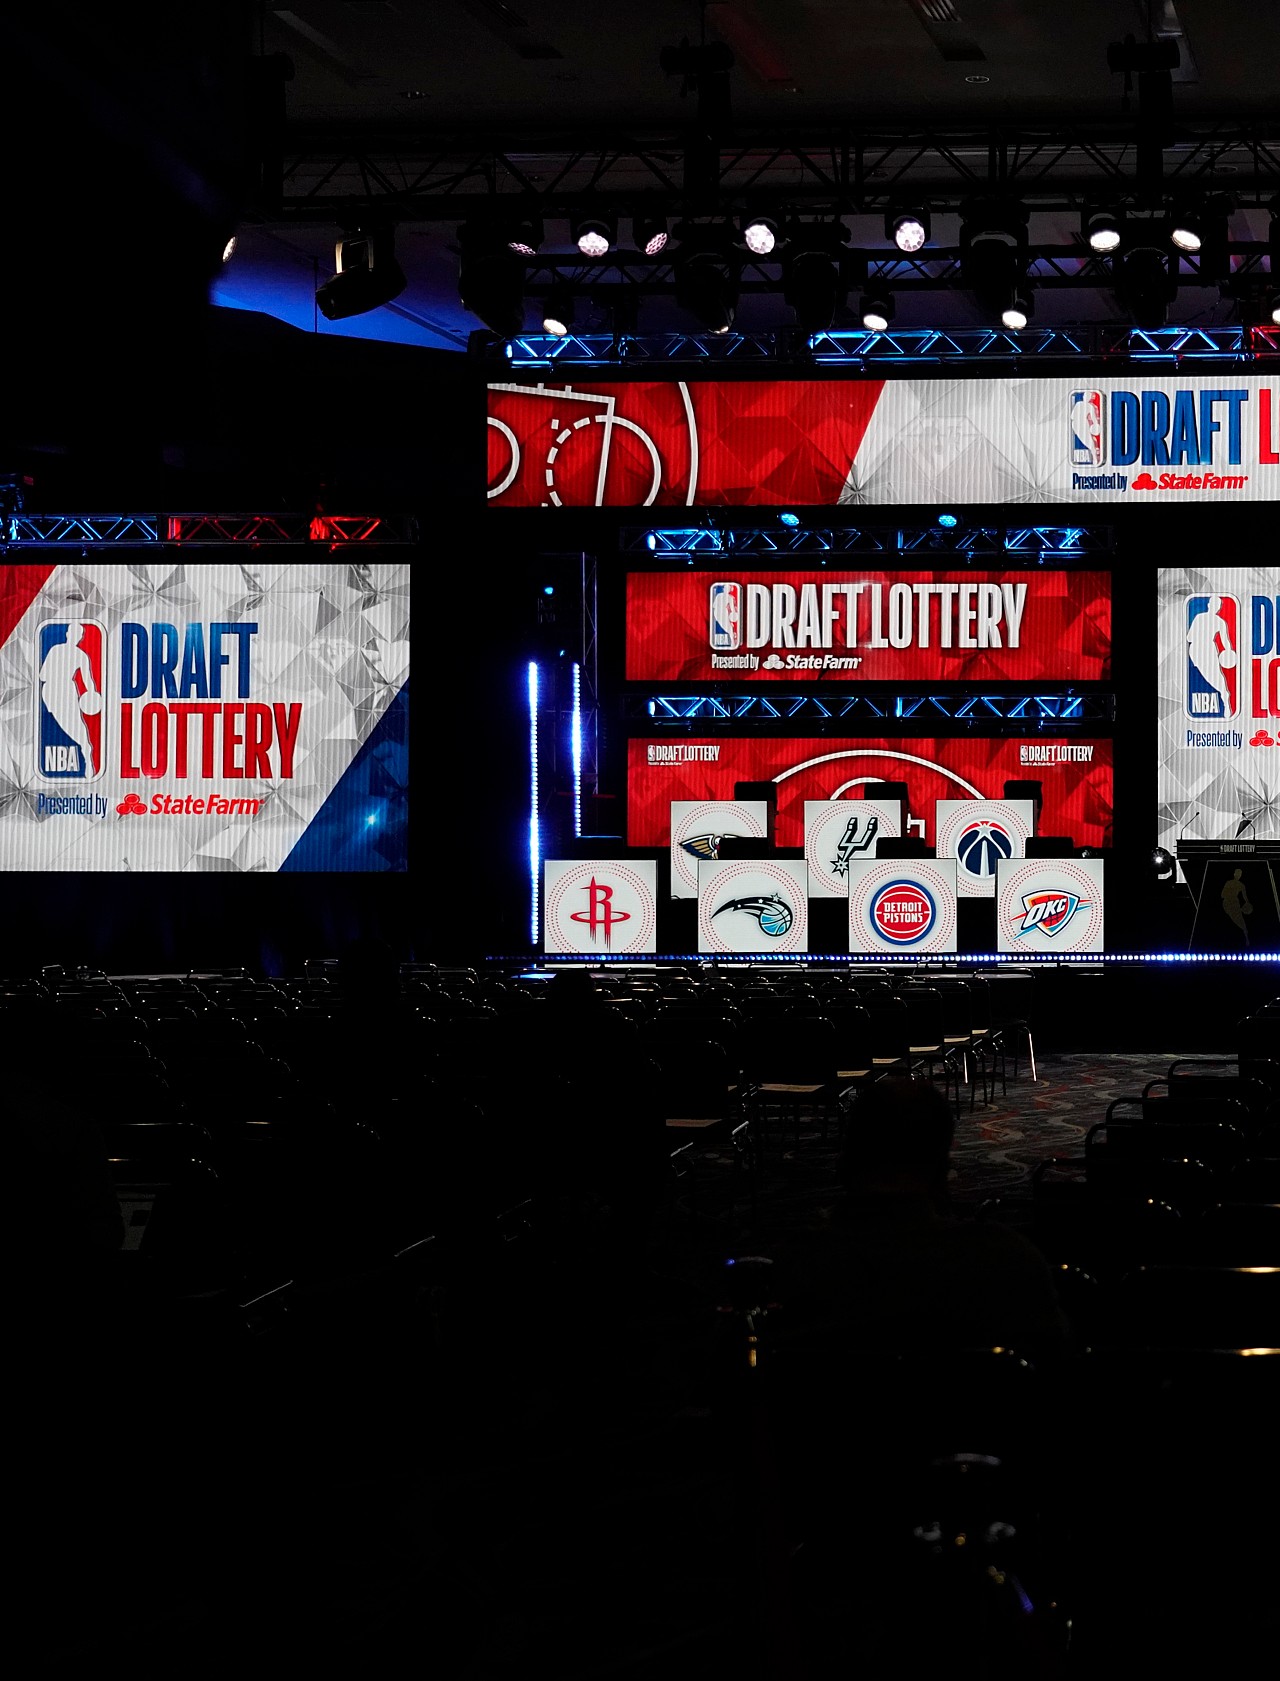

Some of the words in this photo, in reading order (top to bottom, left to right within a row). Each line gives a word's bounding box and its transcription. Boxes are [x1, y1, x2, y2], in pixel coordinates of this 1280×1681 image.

[1111, 390, 1248, 466] DRAFT
[1073, 473, 1115, 490] Presented
[1117, 473, 1127, 492] by
[747, 584, 863, 648] DRAFT
[872, 583, 1027, 648] LOTTERY
[121, 622, 258, 699] DRAFT
[712, 654, 749, 669] Presented
[750, 654, 759, 671] by
[1192, 692, 1219, 713] NBA
[121, 702, 302, 779] LOTTERY
[1187, 730, 1231, 747] Presented
[1232, 730, 1242, 749] by
[45, 746, 79, 772] NBA
[656, 745, 683, 761] DRAFT
[684, 745, 720, 761] LOTTERY
[1029, 745, 1056, 761] DRAFT
[1057, 745, 1093, 761] LOTTERY
[38, 793, 92, 815] Presented
[95, 793, 107, 818] by
[883, 902, 922, 912] DETROIT
[883, 912, 923, 923] PISTONS
[1024, 898, 1067, 929] OKC
